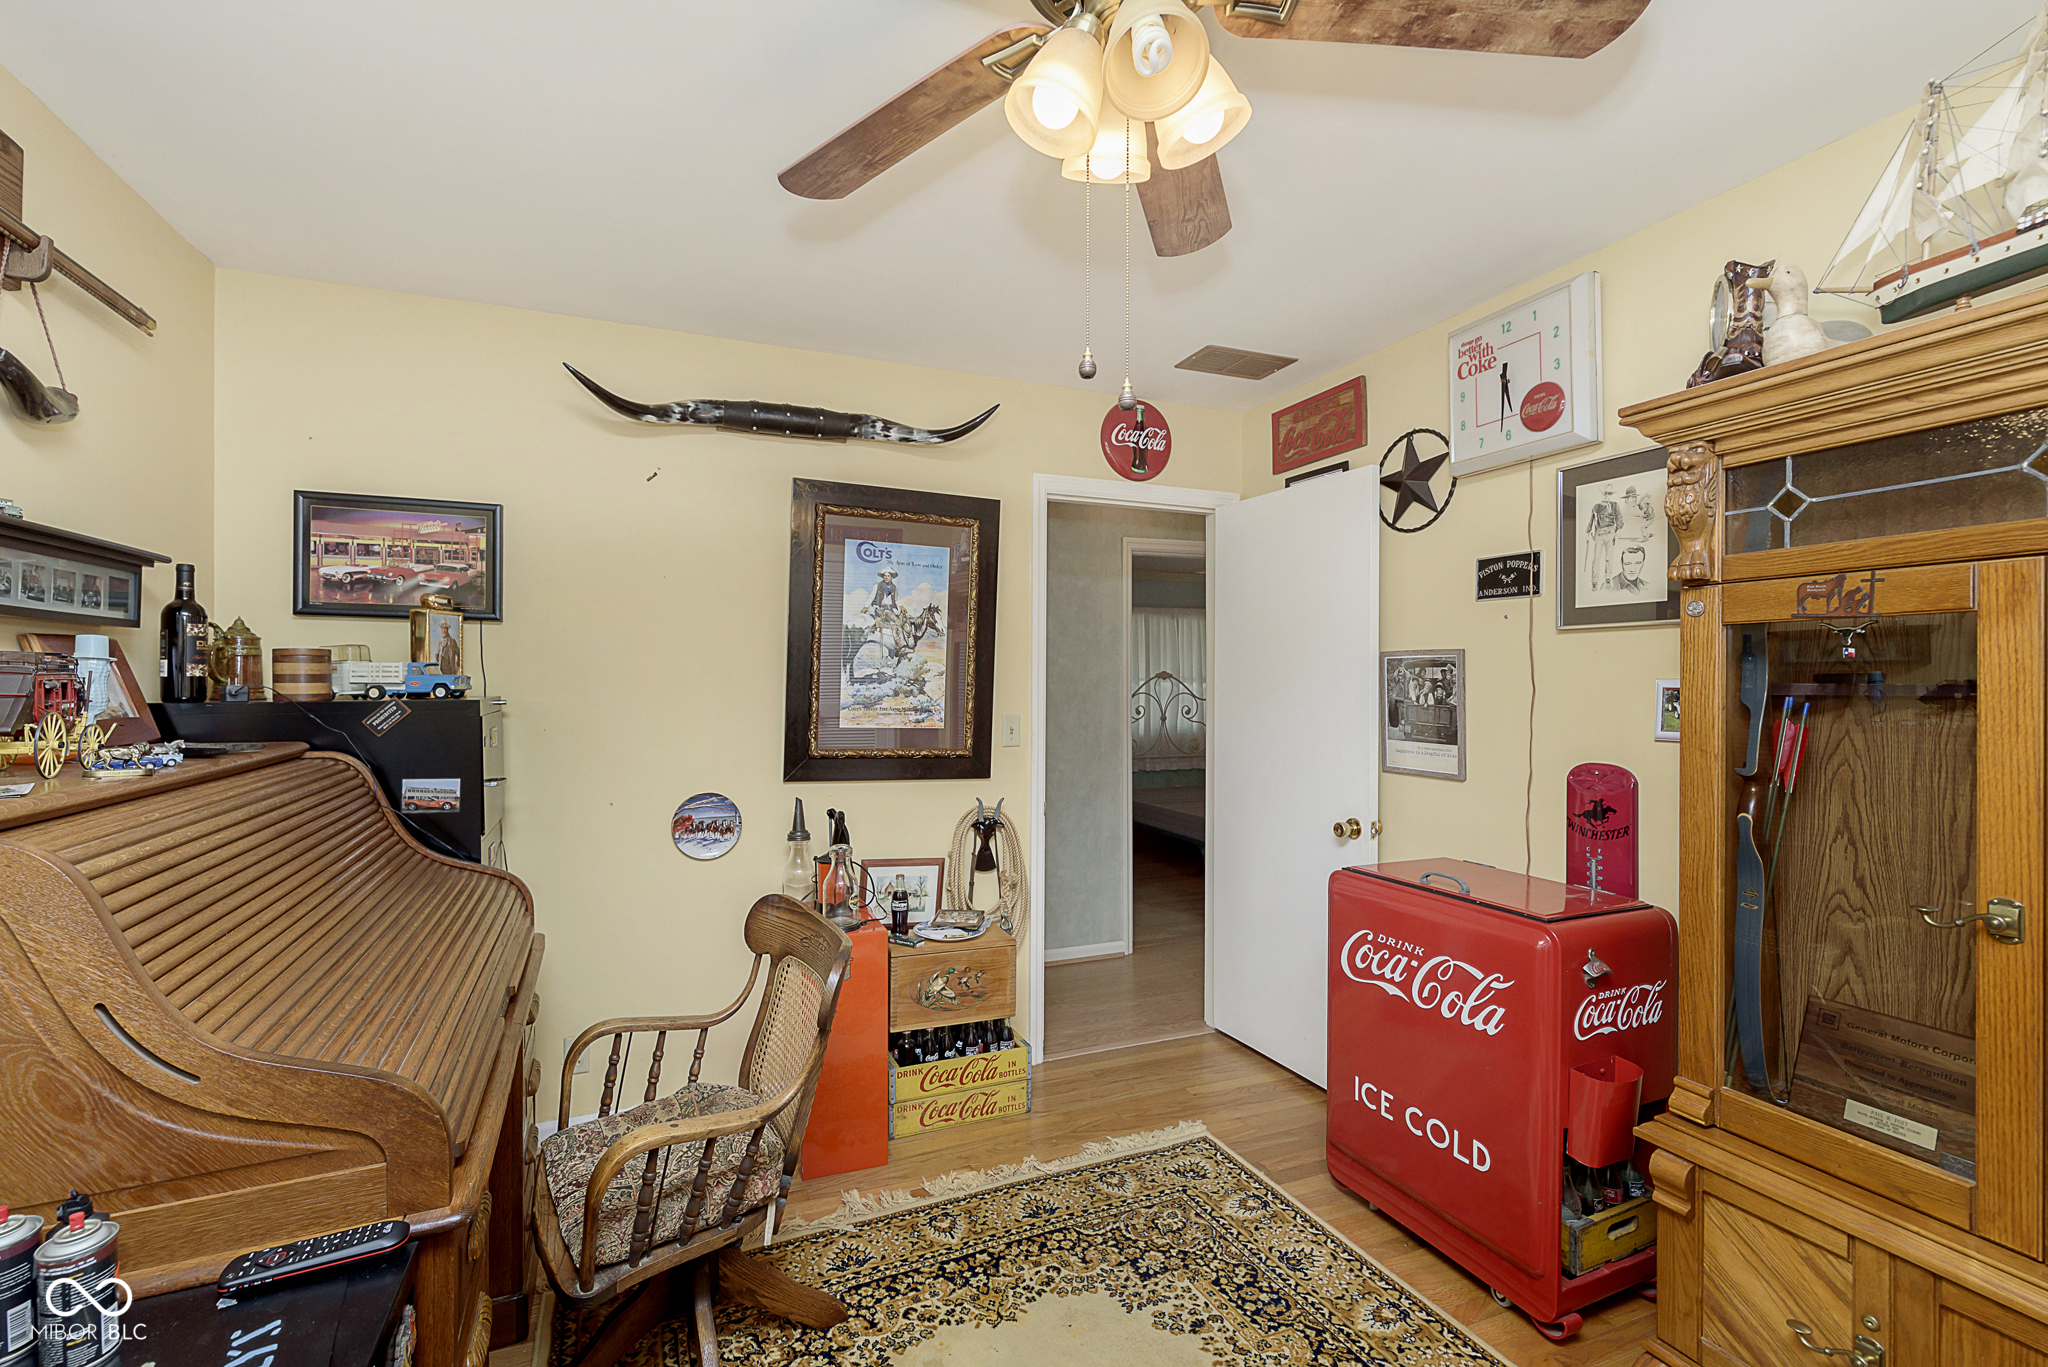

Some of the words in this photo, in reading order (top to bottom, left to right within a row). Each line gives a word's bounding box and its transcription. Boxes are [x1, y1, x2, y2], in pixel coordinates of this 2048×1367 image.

[1532, 310, 1537, 321] 1
[1501, 321, 1512, 334] 12
[1553, 326, 1560, 338] 2
[1474, 335, 1483, 343] go
[1458, 343, 1483, 359] better
[1468, 342, 1494, 363] with
[1457, 355, 1497, 380] Coke
[1554, 358, 1561, 370] 3
[1460, 392, 1466, 402] 9
[1292, 395, 1339, 425] ALWAYS
[1460, 420, 1466, 431] 8
[1505, 429, 1512, 441] 6
[1479, 438, 1484, 449] 7
[1478, 561, 1504, 579] PISTON
[1506, 560, 1539, 573] POPPERS
[1478, 586, 1518, 597] ANDERSON
[1567, 816, 1630, 840] WINCHESTER
[1376, 933, 1425, 957] DRINK
[1340, 929, 1515, 1036] Coca-Cola
[1598, 987, 1627, 1000] DRINK
[1574, 979, 1667, 1041] Coca-Cola
[1846, 1022, 1888, 1039] General
[1890, 1034, 1929, 1051] Motors
[1932, 1046, 1976, 1065] Corpor
[1008, 1060, 1017, 1068] IN
[897, 1067, 924, 1079] DRINK
[920, 1054, 1002, 1092] Coca-Cola
[998, 1067, 1026, 1079] BOTTLES
[1844, 1059, 1885, 1077] Presented
[1898, 1077, 1957, 1100] Appreciation
[1007, 1095, 1016, 1103] IN
[897, 1102, 924, 1114] DRINK
[919, 1089, 1001, 1127] Coca-Cola
[998, 1102, 1026, 1113] BOTTLES
[1354, 1076, 1394, 1121] ICE
[1405, 1107, 1491, 1172] COLD
